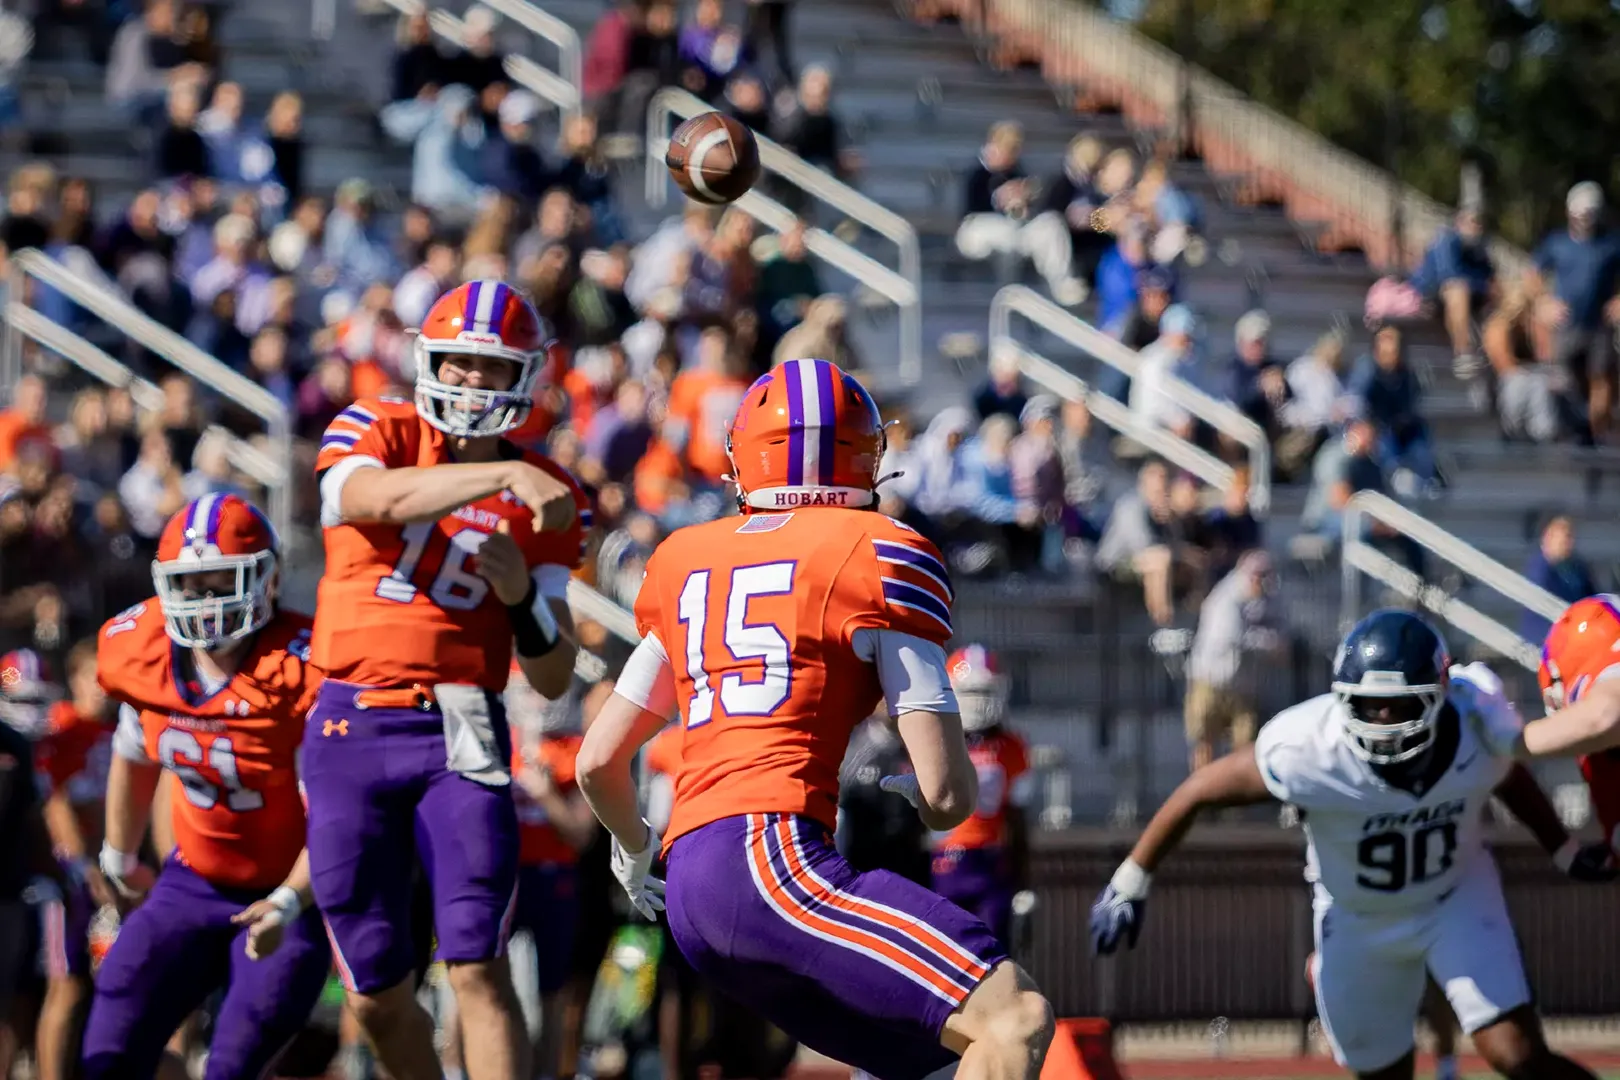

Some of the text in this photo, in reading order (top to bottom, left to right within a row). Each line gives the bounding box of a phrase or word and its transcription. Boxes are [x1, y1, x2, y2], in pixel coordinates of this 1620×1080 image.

[774, 491, 848, 505] HOBART
[374, 521, 490, 611] 16
[678, 560, 798, 730] 15
[158, 727, 264, 811] 61
[1357, 821, 1457, 892] 90
